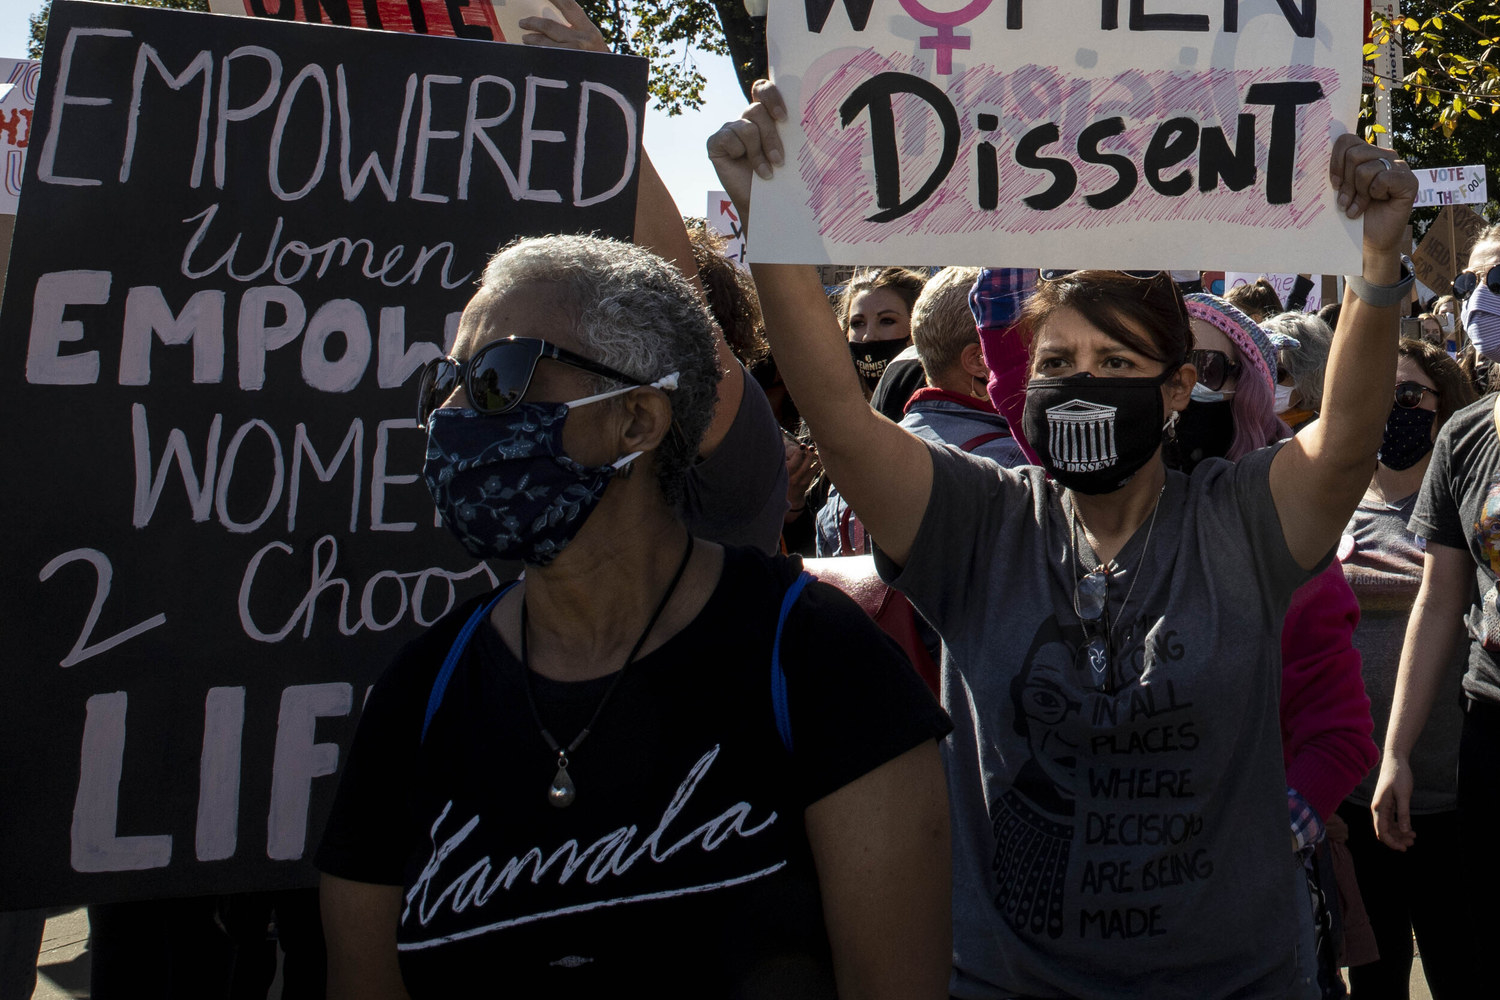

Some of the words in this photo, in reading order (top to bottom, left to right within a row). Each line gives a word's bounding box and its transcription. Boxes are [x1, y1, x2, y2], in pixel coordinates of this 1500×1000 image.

[37, 26, 639, 207] EMPOWERED
[1429, 167, 1465, 183] VOTE
[1436, 189, 1461, 205] THE
[1458, 172, 1485, 199] FOOL
[132, 404, 442, 533] WOME
[1052, 458, 1065, 471] WE
[1067, 457, 1119, 473] DISSENT
[39, 548, 167, 668] 2
[1092, 698, 1118, 727] IN
[1131, 677, 1193, 722] ALL
[1090, 723, 1200, 755] PLACES
[70, 682, 373, 873] LIF
[1088, 767, 1195, 799] WHERE
[1081, 859, 1133, 894] ARE
[1142, 848, 1214, 891] BEING
[1079, 905, 1168, 940] MADE
